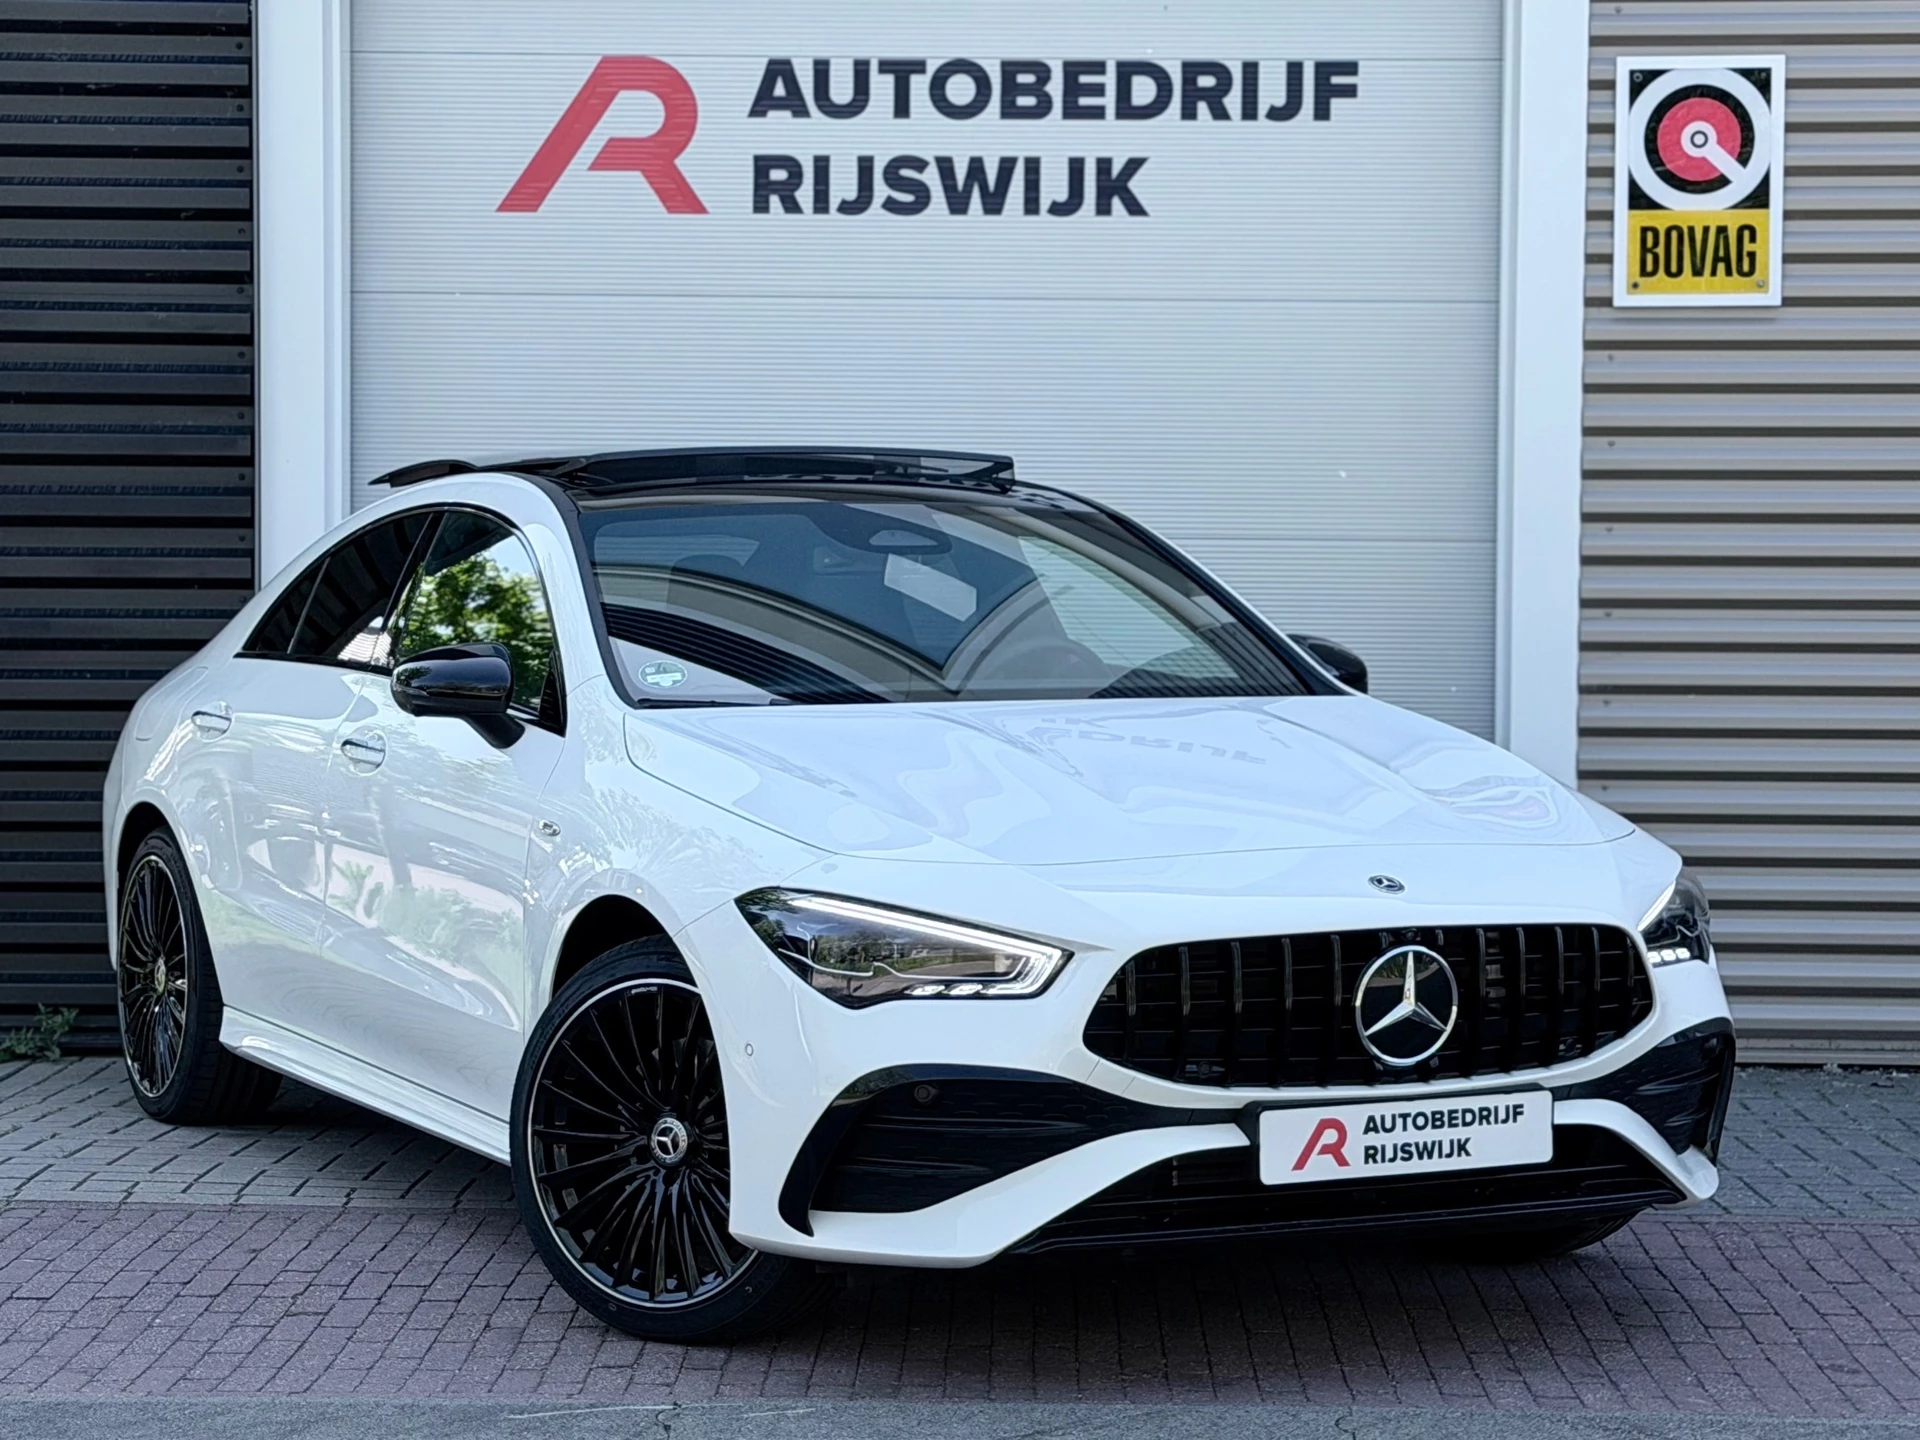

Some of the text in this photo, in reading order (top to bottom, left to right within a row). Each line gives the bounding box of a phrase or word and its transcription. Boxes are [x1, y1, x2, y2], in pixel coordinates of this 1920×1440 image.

[748, 58, 1359, 121] AUTOBEDRIJF
[752, 154, 1149, 217] RIJSWIJK
[1639, 224, 1757, 279] BOVAG
[1363, 1103, 1525, 1135] AUTOBEDRIJF
[1363, 1137, 1472, 1165] RIJSWIJK
